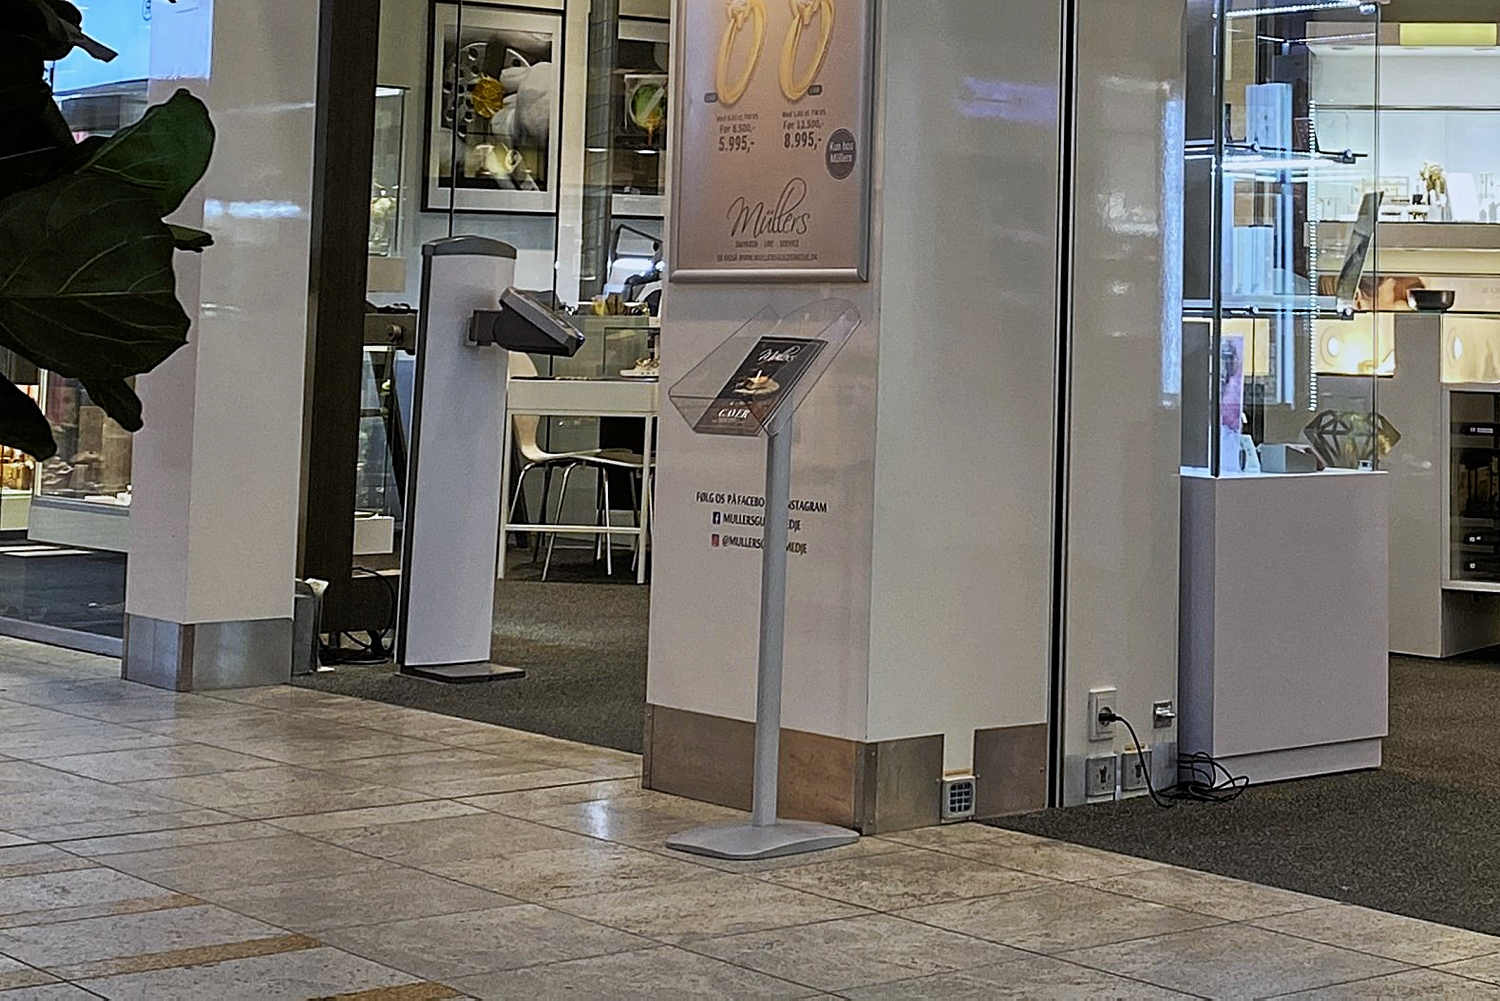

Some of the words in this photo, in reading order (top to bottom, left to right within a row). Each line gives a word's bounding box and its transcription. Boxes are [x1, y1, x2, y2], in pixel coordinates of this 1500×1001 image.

[718, 134, 755, 154] 5.995,-
[783, 131, 822, 150] 8.995,-
[726, 176, 811, 239] Müllers
[696, 491, 714, 504] FØLG
[715, 493, 725, 504] OS
[727, 492, 737, 506] PÅ
[737, 495, 765, 508] FACEBO
[787, 499, 827, 513] STAGRAM
